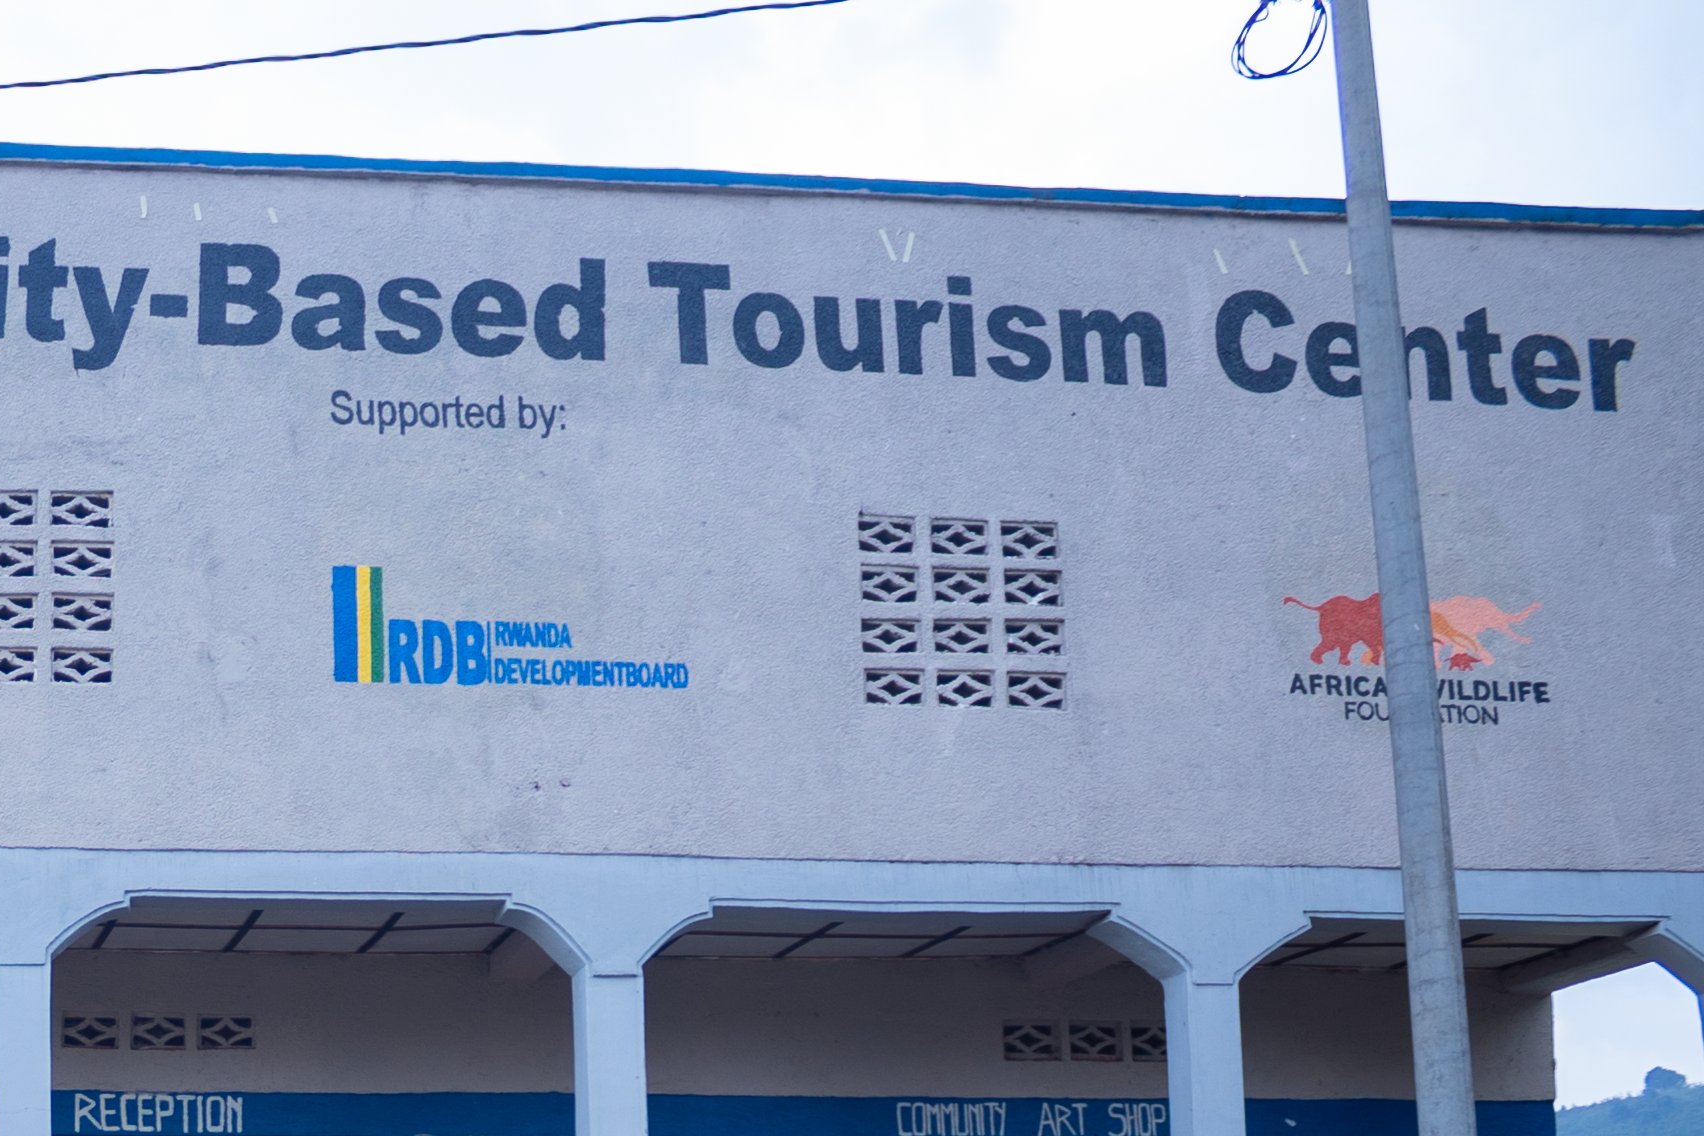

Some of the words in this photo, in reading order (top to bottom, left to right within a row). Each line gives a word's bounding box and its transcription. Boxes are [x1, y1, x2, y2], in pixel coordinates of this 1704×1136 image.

[648, 260, 1168, 388] Tourism
[1214, 288, 1637, 413] Center
[330, 389, 506, 436] Supported
[517, 395, 566, 439] by:
[387, 618, 488, 686] RDB
[495, 621, 573, 648] RWANDA
[1290, 673, 1388, 697] AFRICA
[74, 1093, 244, 1133] RECEPTION
